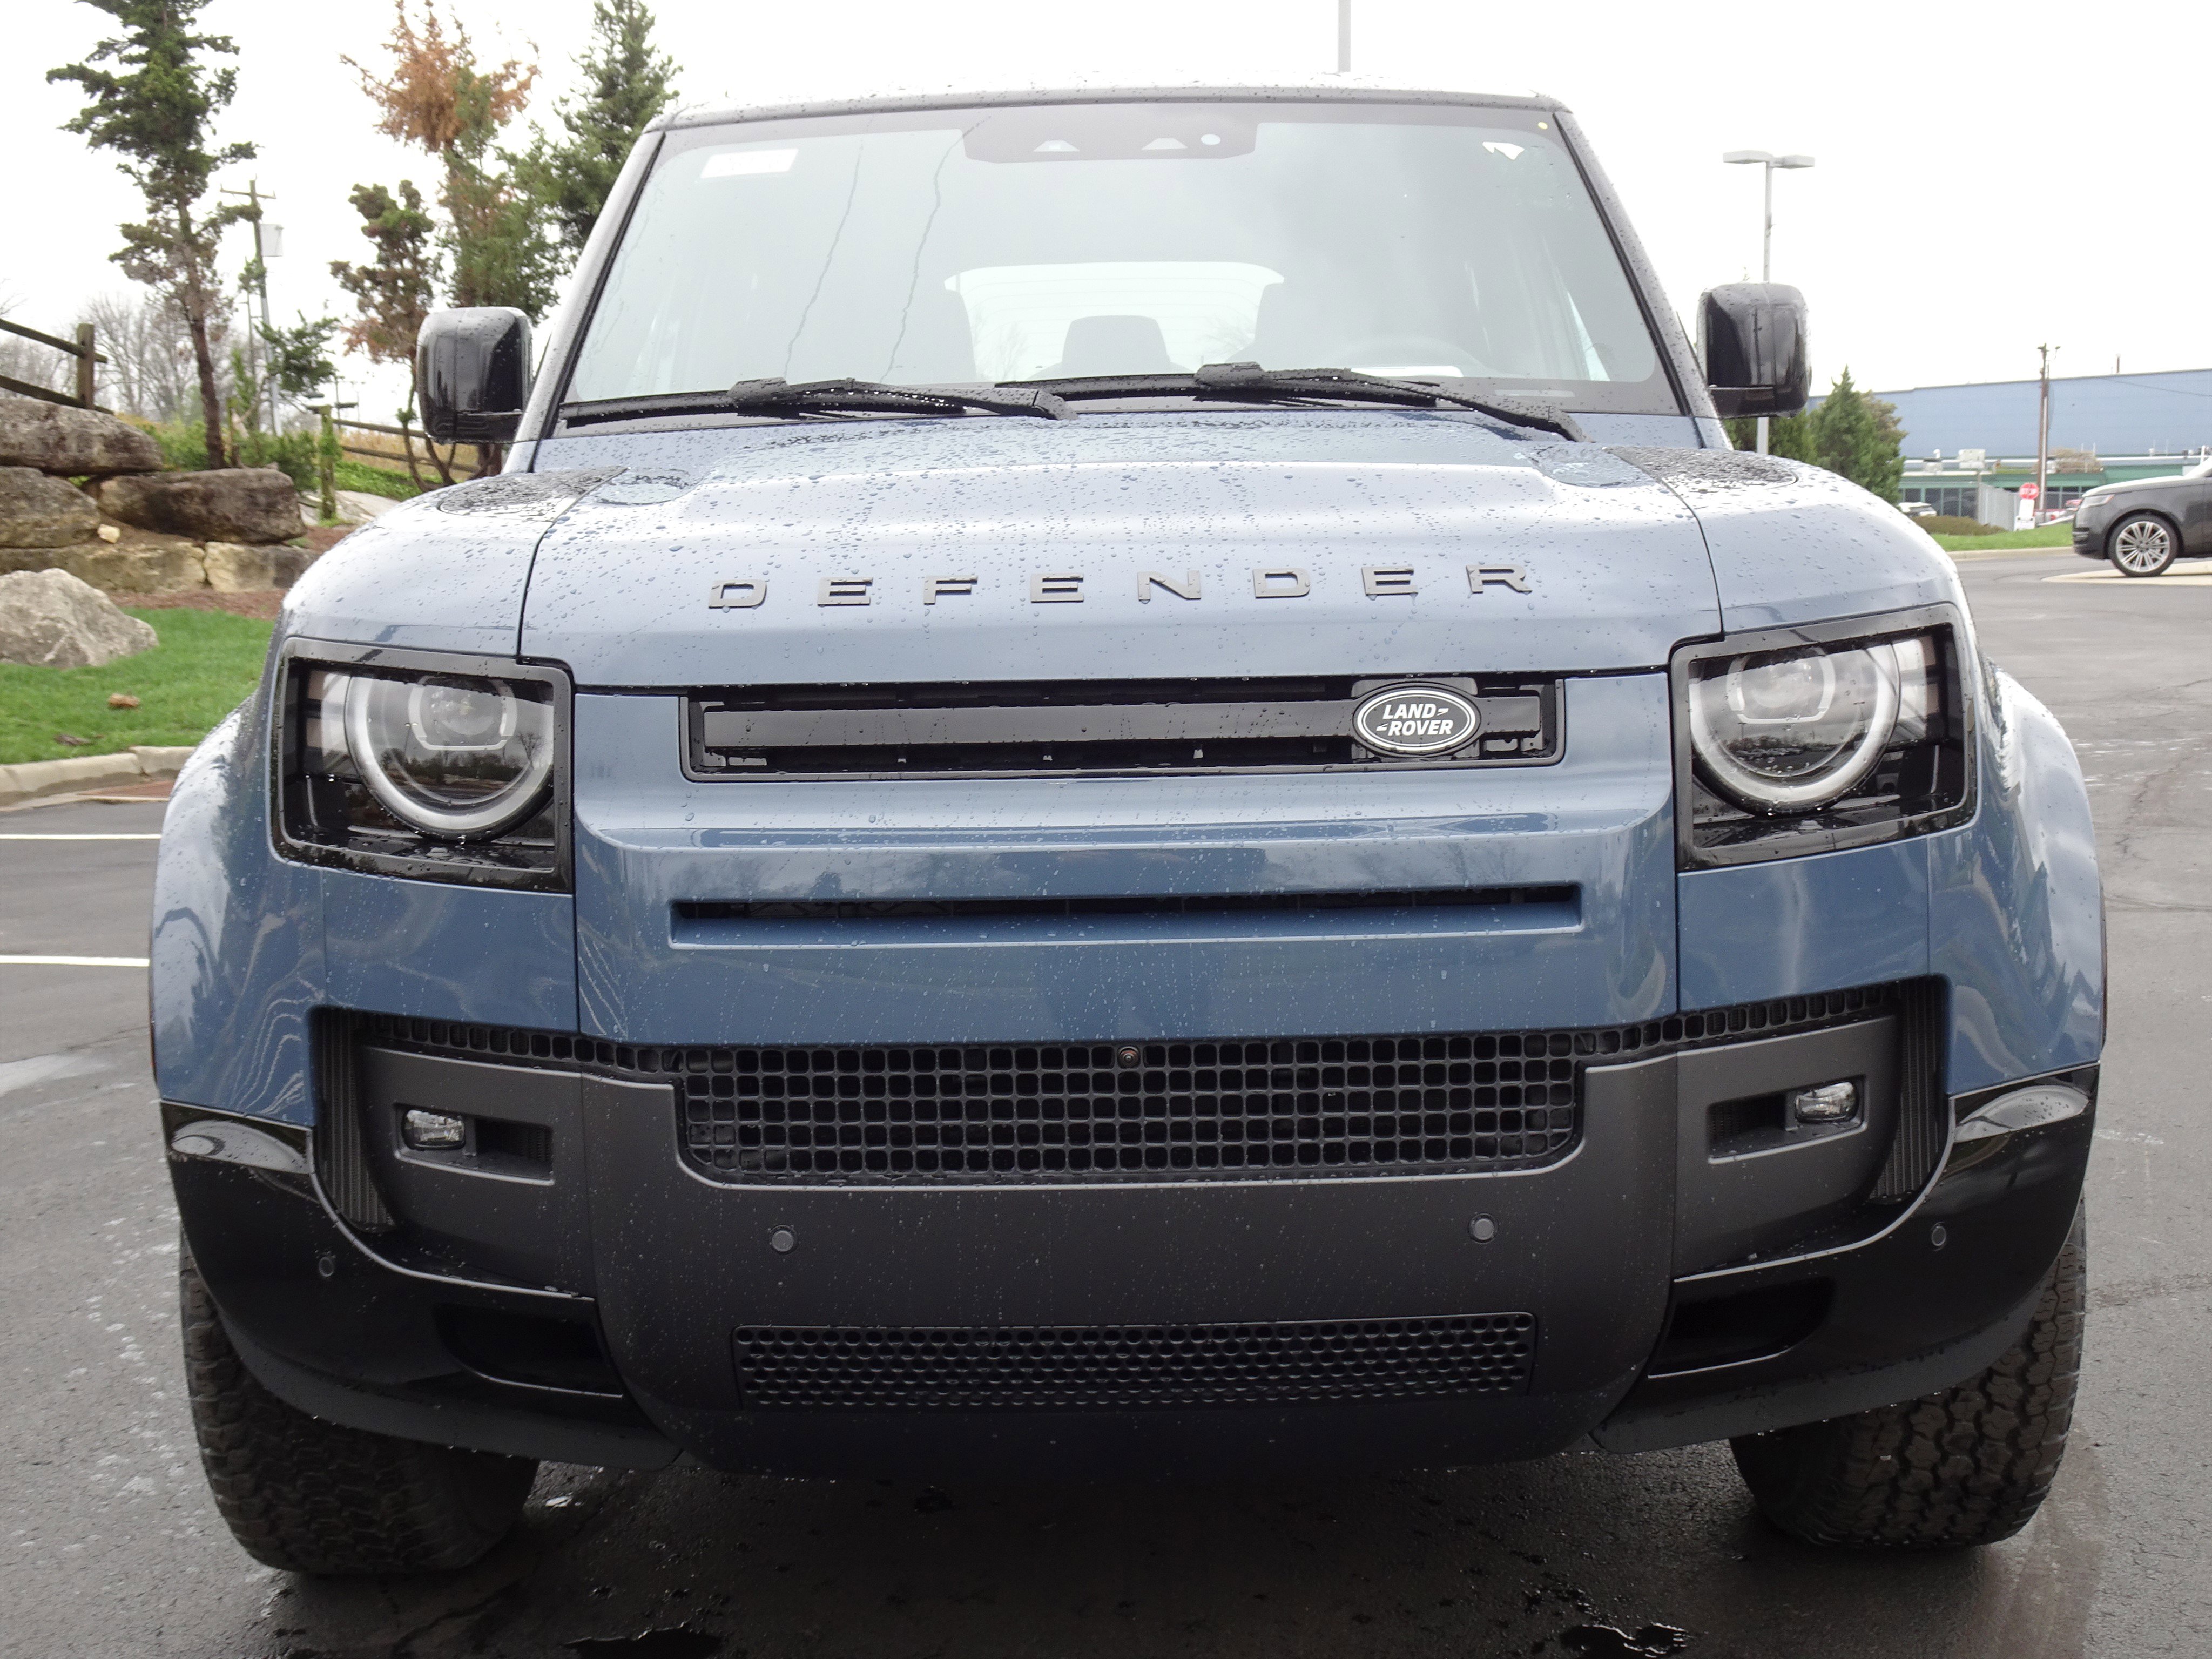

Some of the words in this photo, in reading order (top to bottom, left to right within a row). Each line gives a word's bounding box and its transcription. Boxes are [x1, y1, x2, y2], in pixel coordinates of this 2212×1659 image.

[709, 564, 1533, 609] DEFENDER
[1383, 704, 1436, 719] LAND
[1388, 720, 1453, 736] ROVER
